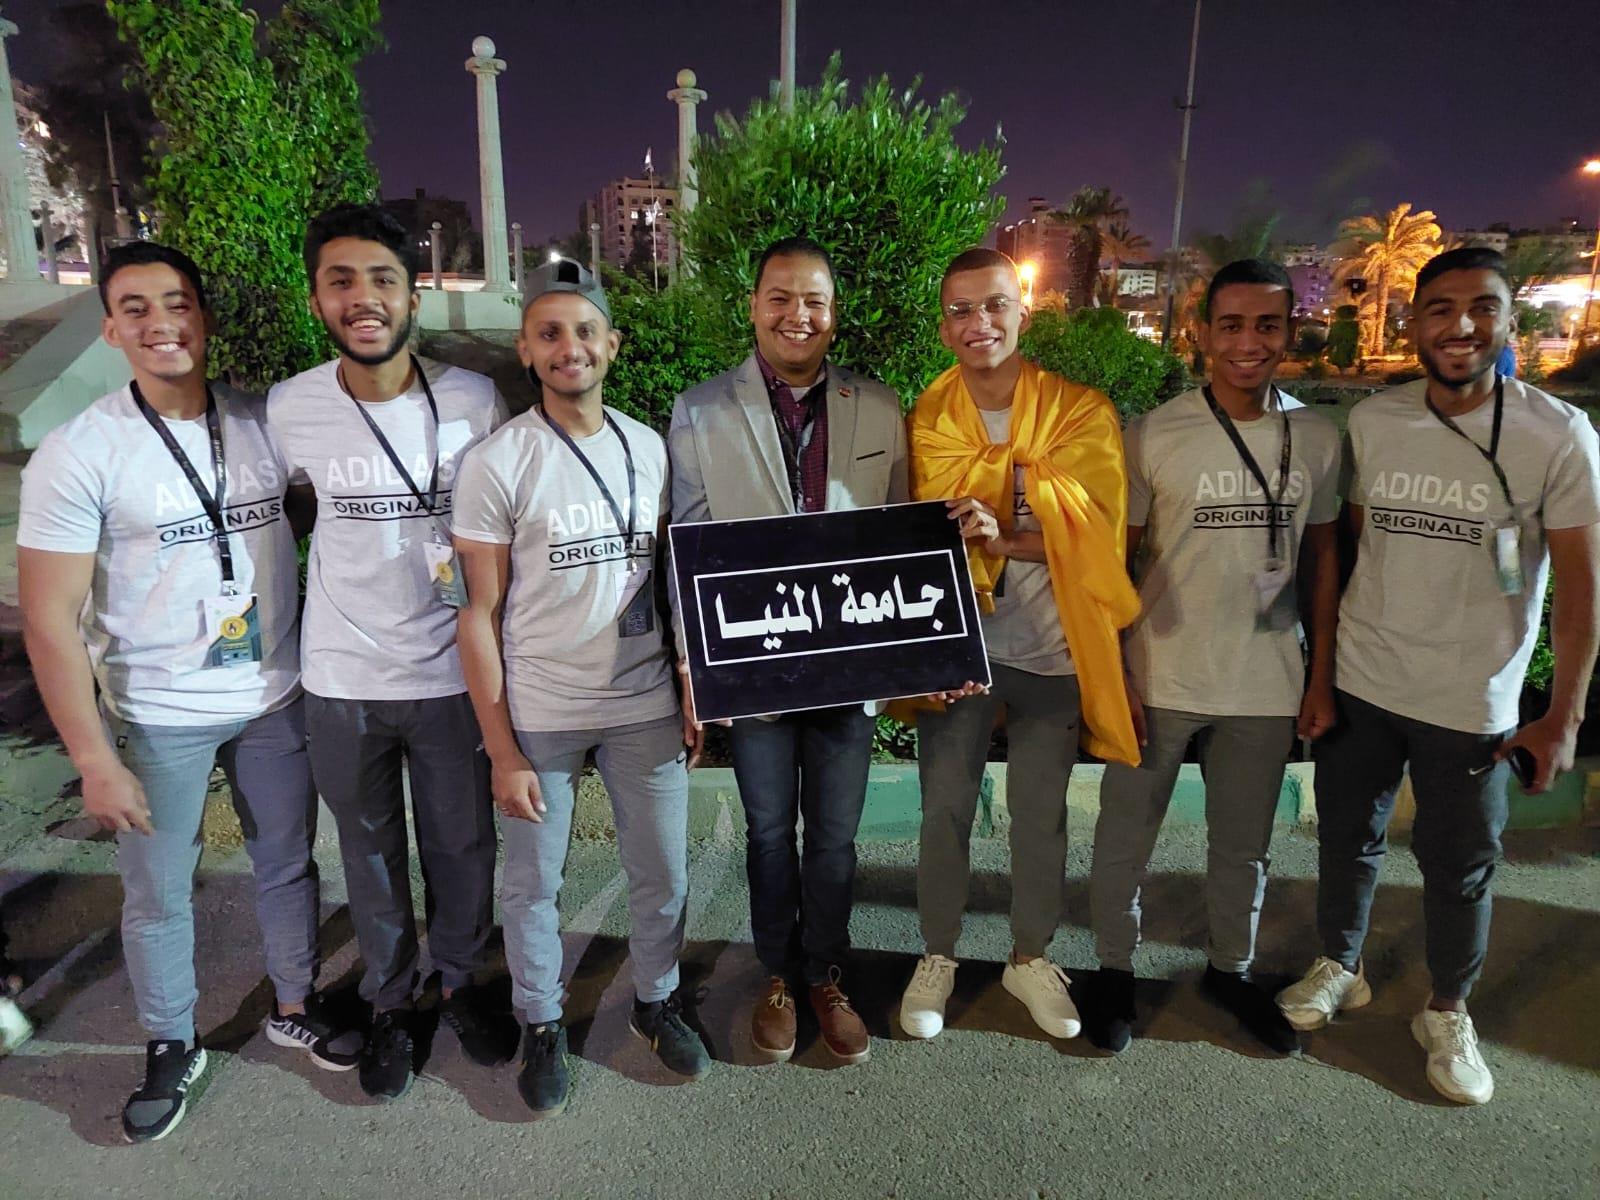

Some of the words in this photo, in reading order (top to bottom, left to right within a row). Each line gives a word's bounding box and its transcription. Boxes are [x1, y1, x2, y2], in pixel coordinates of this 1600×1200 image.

[155, 459, 280, 517] ADAS
[1195, 469, 1304, 501] ADIDAS
[1369, 470, 1491, 513] ADIDAS
[159, 503, 280, 542] ORIGNALS
[1371, 512, 1483, 540] ORIGINALS
[715, 581, 823, 650] المنيا
[832, 573, 944, 632] جامعة
